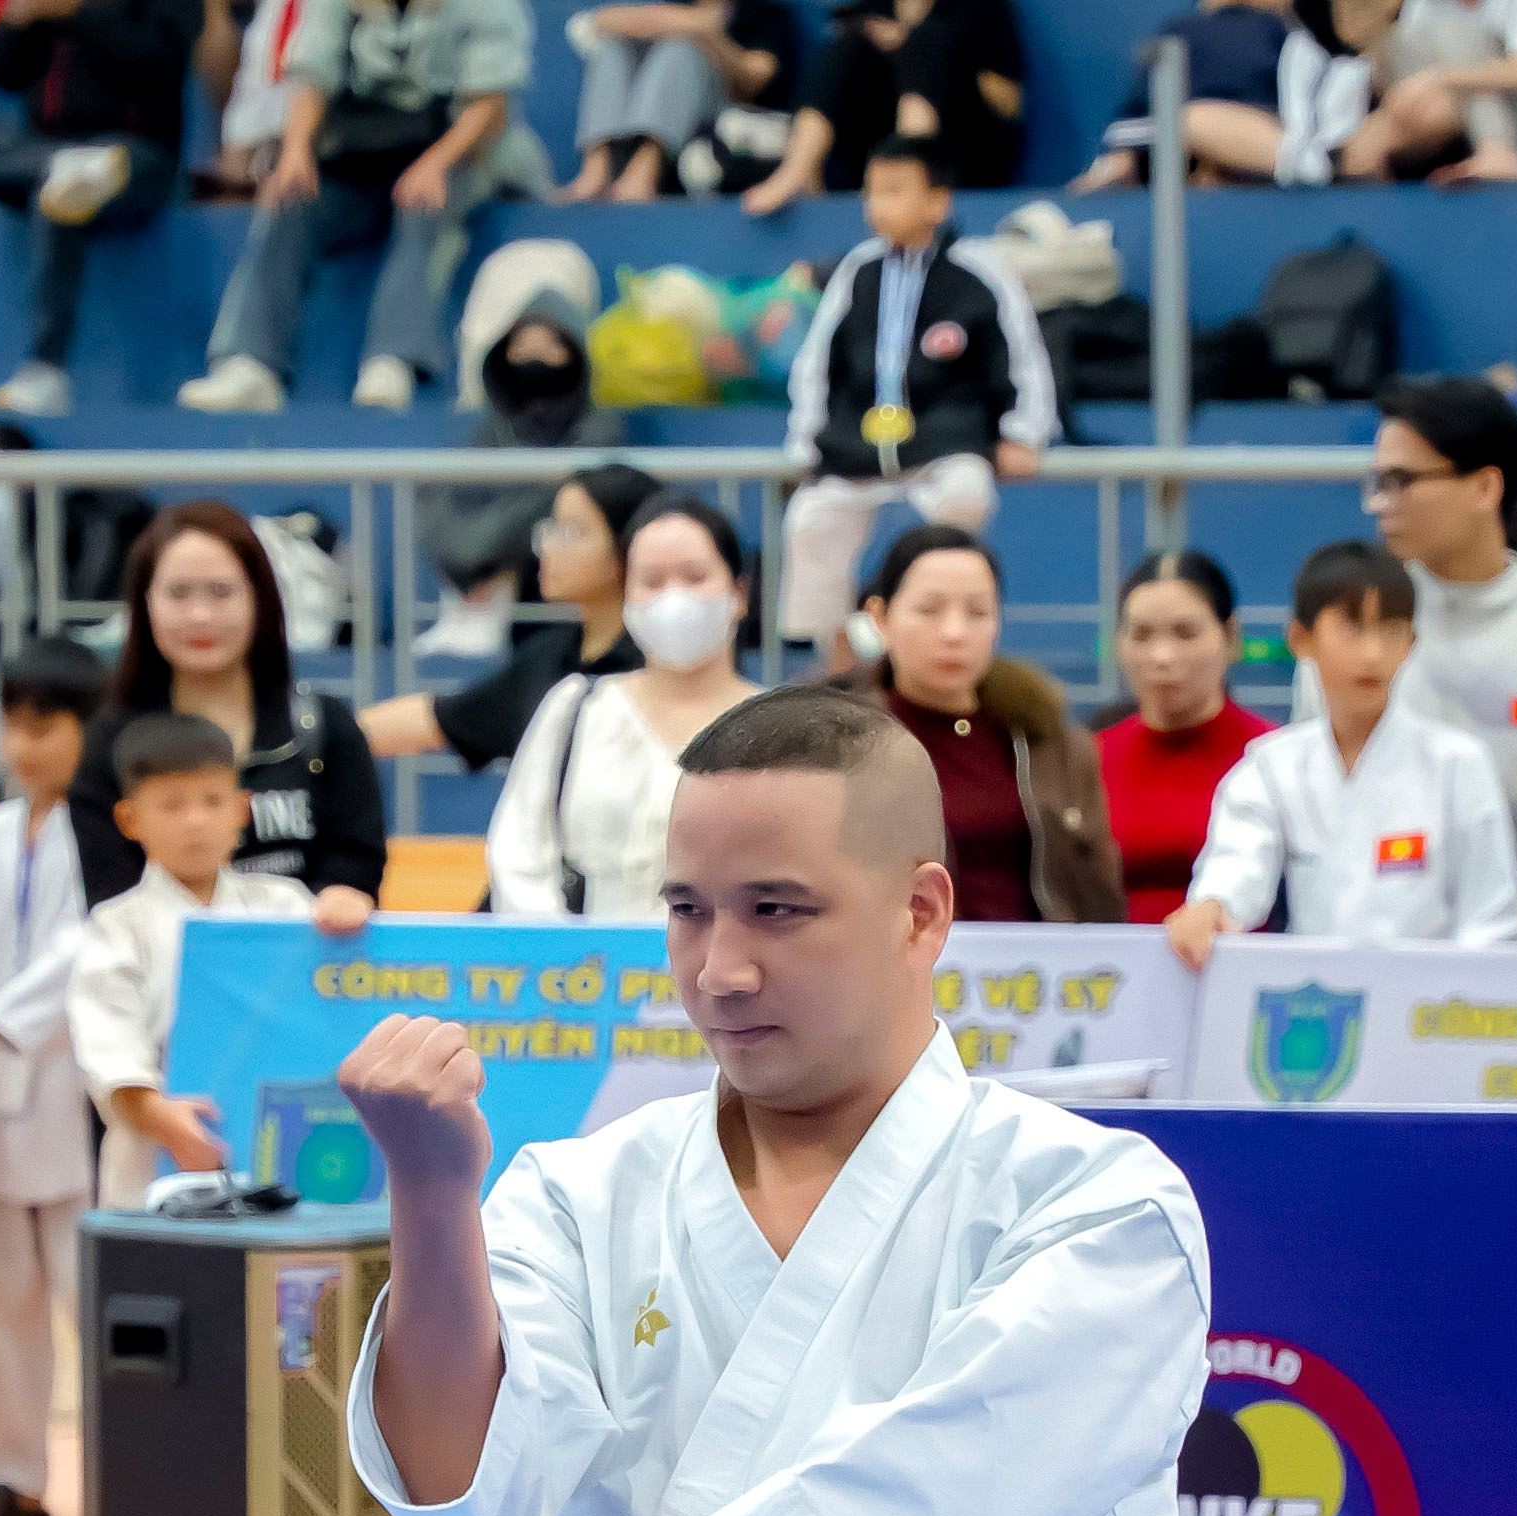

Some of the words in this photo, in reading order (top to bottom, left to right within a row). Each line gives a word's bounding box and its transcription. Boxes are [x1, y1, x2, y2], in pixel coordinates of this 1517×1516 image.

[313, 960, 449, 999] CÔNG
[465, 966, 524, 1002] TY
[1208, 1338, 1303, 1387] ORLD
